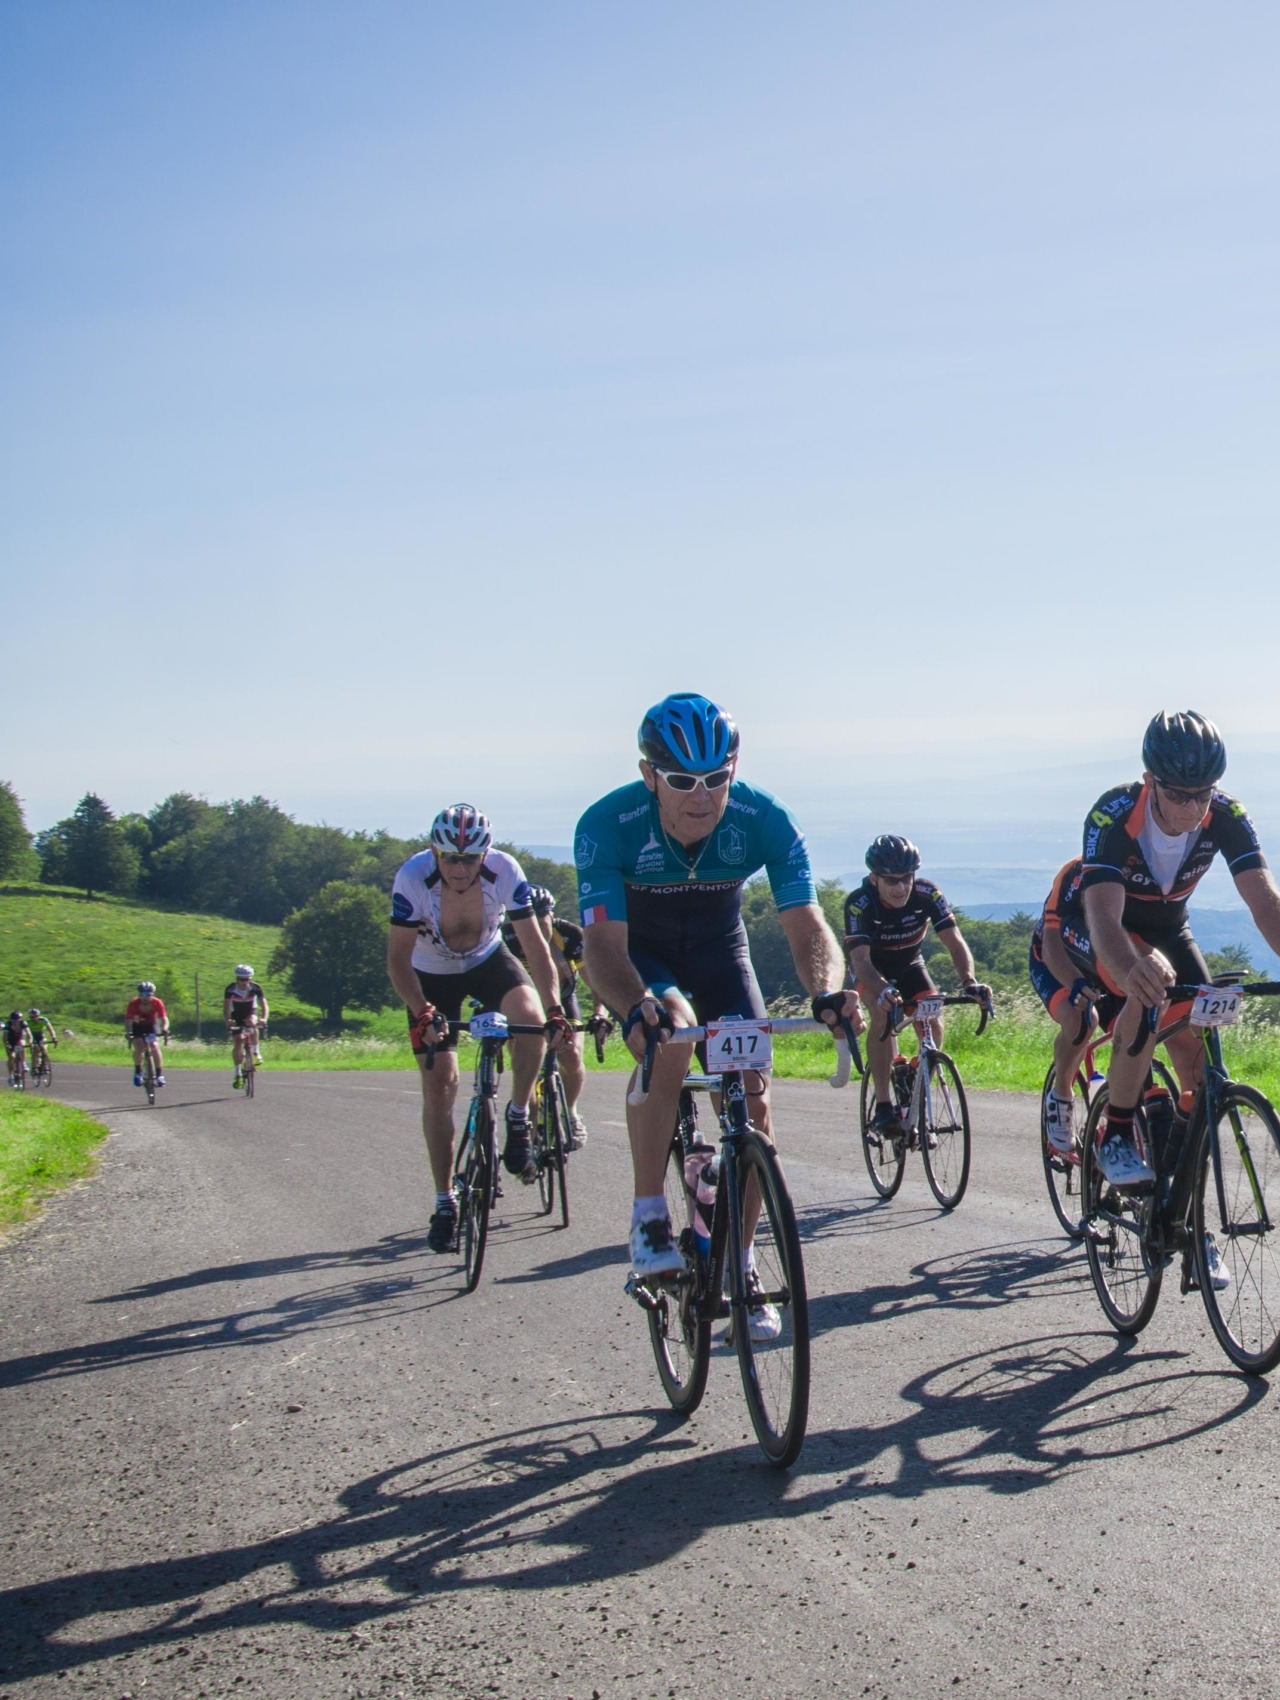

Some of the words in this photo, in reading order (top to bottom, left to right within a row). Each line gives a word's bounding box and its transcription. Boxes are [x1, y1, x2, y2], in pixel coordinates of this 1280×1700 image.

[619, 801, 650, 823] Santini
[727, 797, 759, 816] Santini
[650, 881, 742, 894] MONTVENTOU
[1202, 998, 1237, 1015] 1214
[721, 1035, 758, 1055] 417
